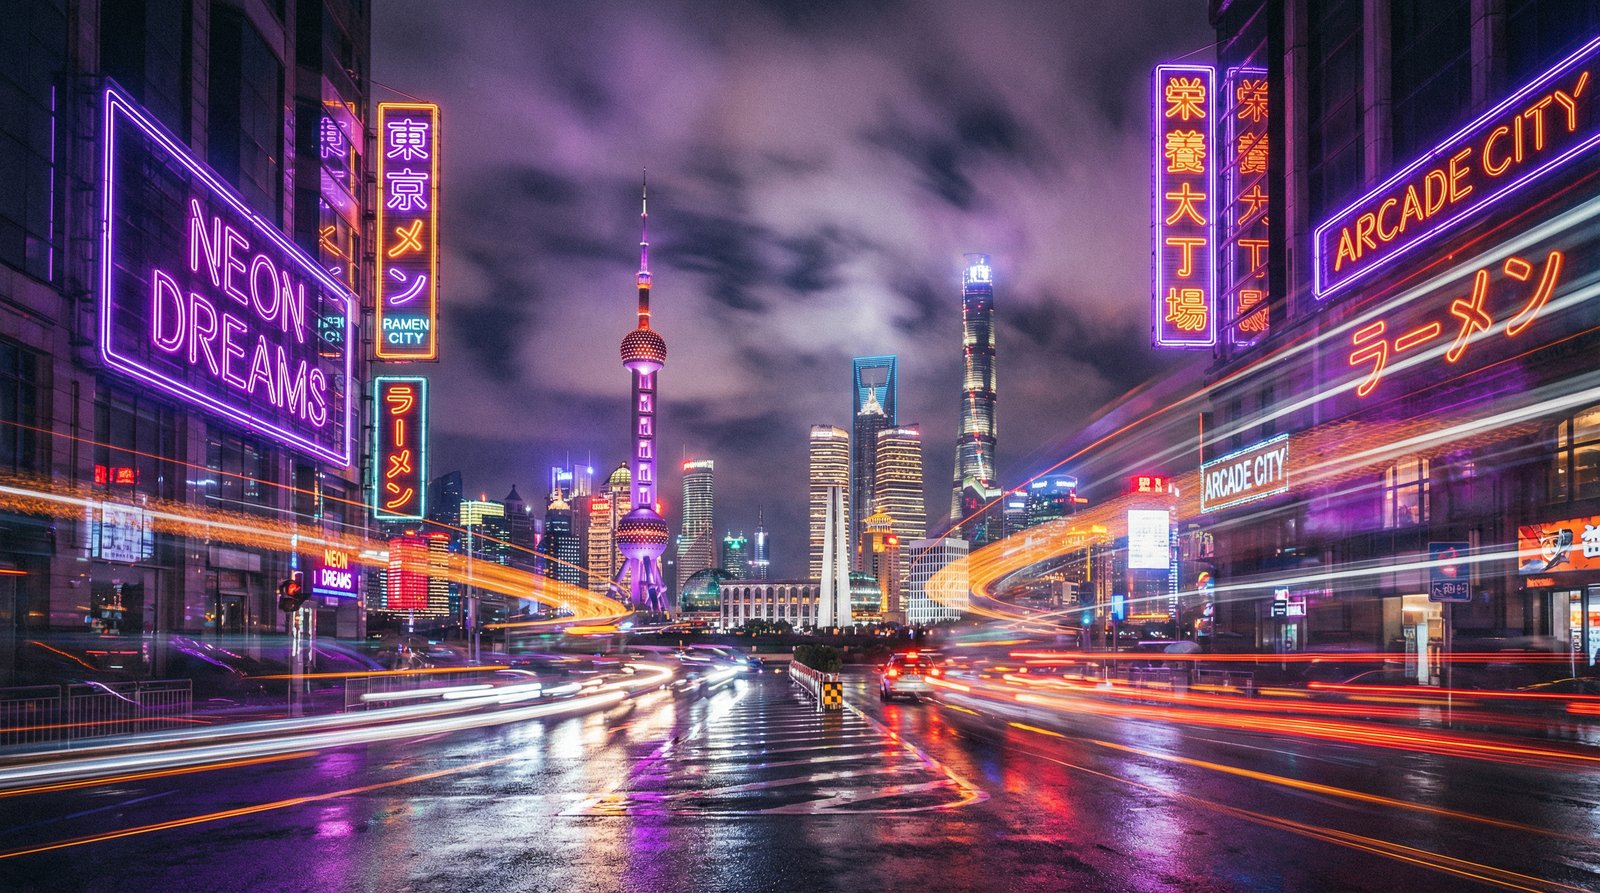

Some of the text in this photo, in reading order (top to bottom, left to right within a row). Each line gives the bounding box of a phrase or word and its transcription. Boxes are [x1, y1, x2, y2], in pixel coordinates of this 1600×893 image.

[387, 118, 429, 304] 東京メン
[1165, 77, 1208, 331] 栄養大丁場
[1334, 72, 1588, 271] ARCADE CITY
[191, 199, 305, 343] NEON
[383, 317, 430, 331] RAMEN
[1350, 251, 1561, 397] ラーメン
[153, 269, 326, 427] DREAMS
[388, 332, 424, 344] CITY
[386, 387, 413, 508] ラーメン
[1205, 460, 1252, 502] ARCADE
[1254, 448, 1285, 487] CITY
[321, 568, 352, 590] DREAMS
[324, 548, 348, 570] NEON
